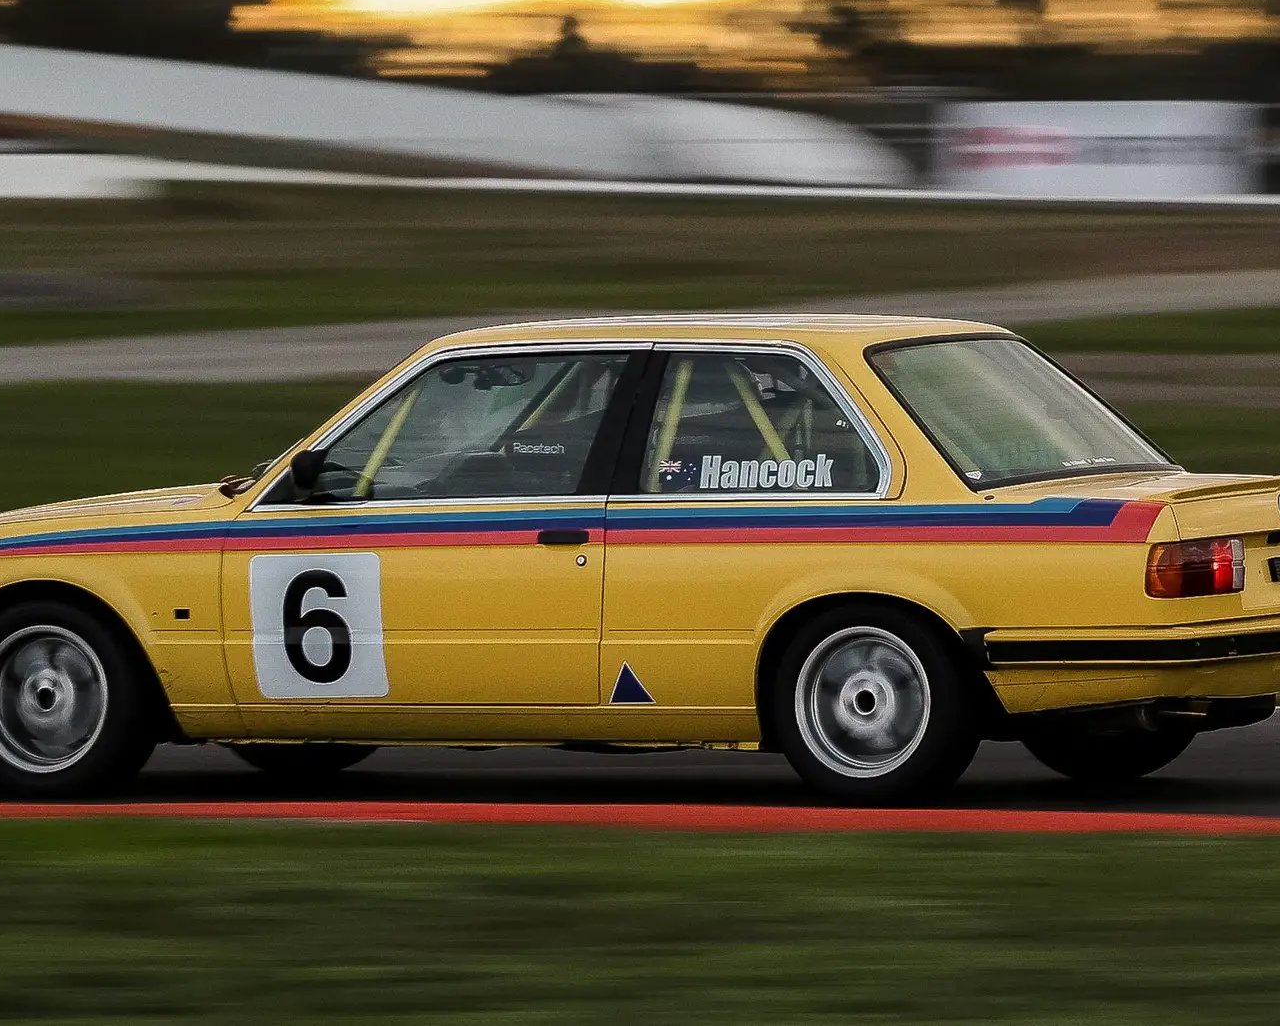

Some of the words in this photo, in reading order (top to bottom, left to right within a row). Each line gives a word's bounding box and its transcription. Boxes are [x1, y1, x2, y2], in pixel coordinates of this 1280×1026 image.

[513, 442, 565, 454] Racetech
[700, 454, 833, 489] Hancock
[283, 568, 352, 684] 6
